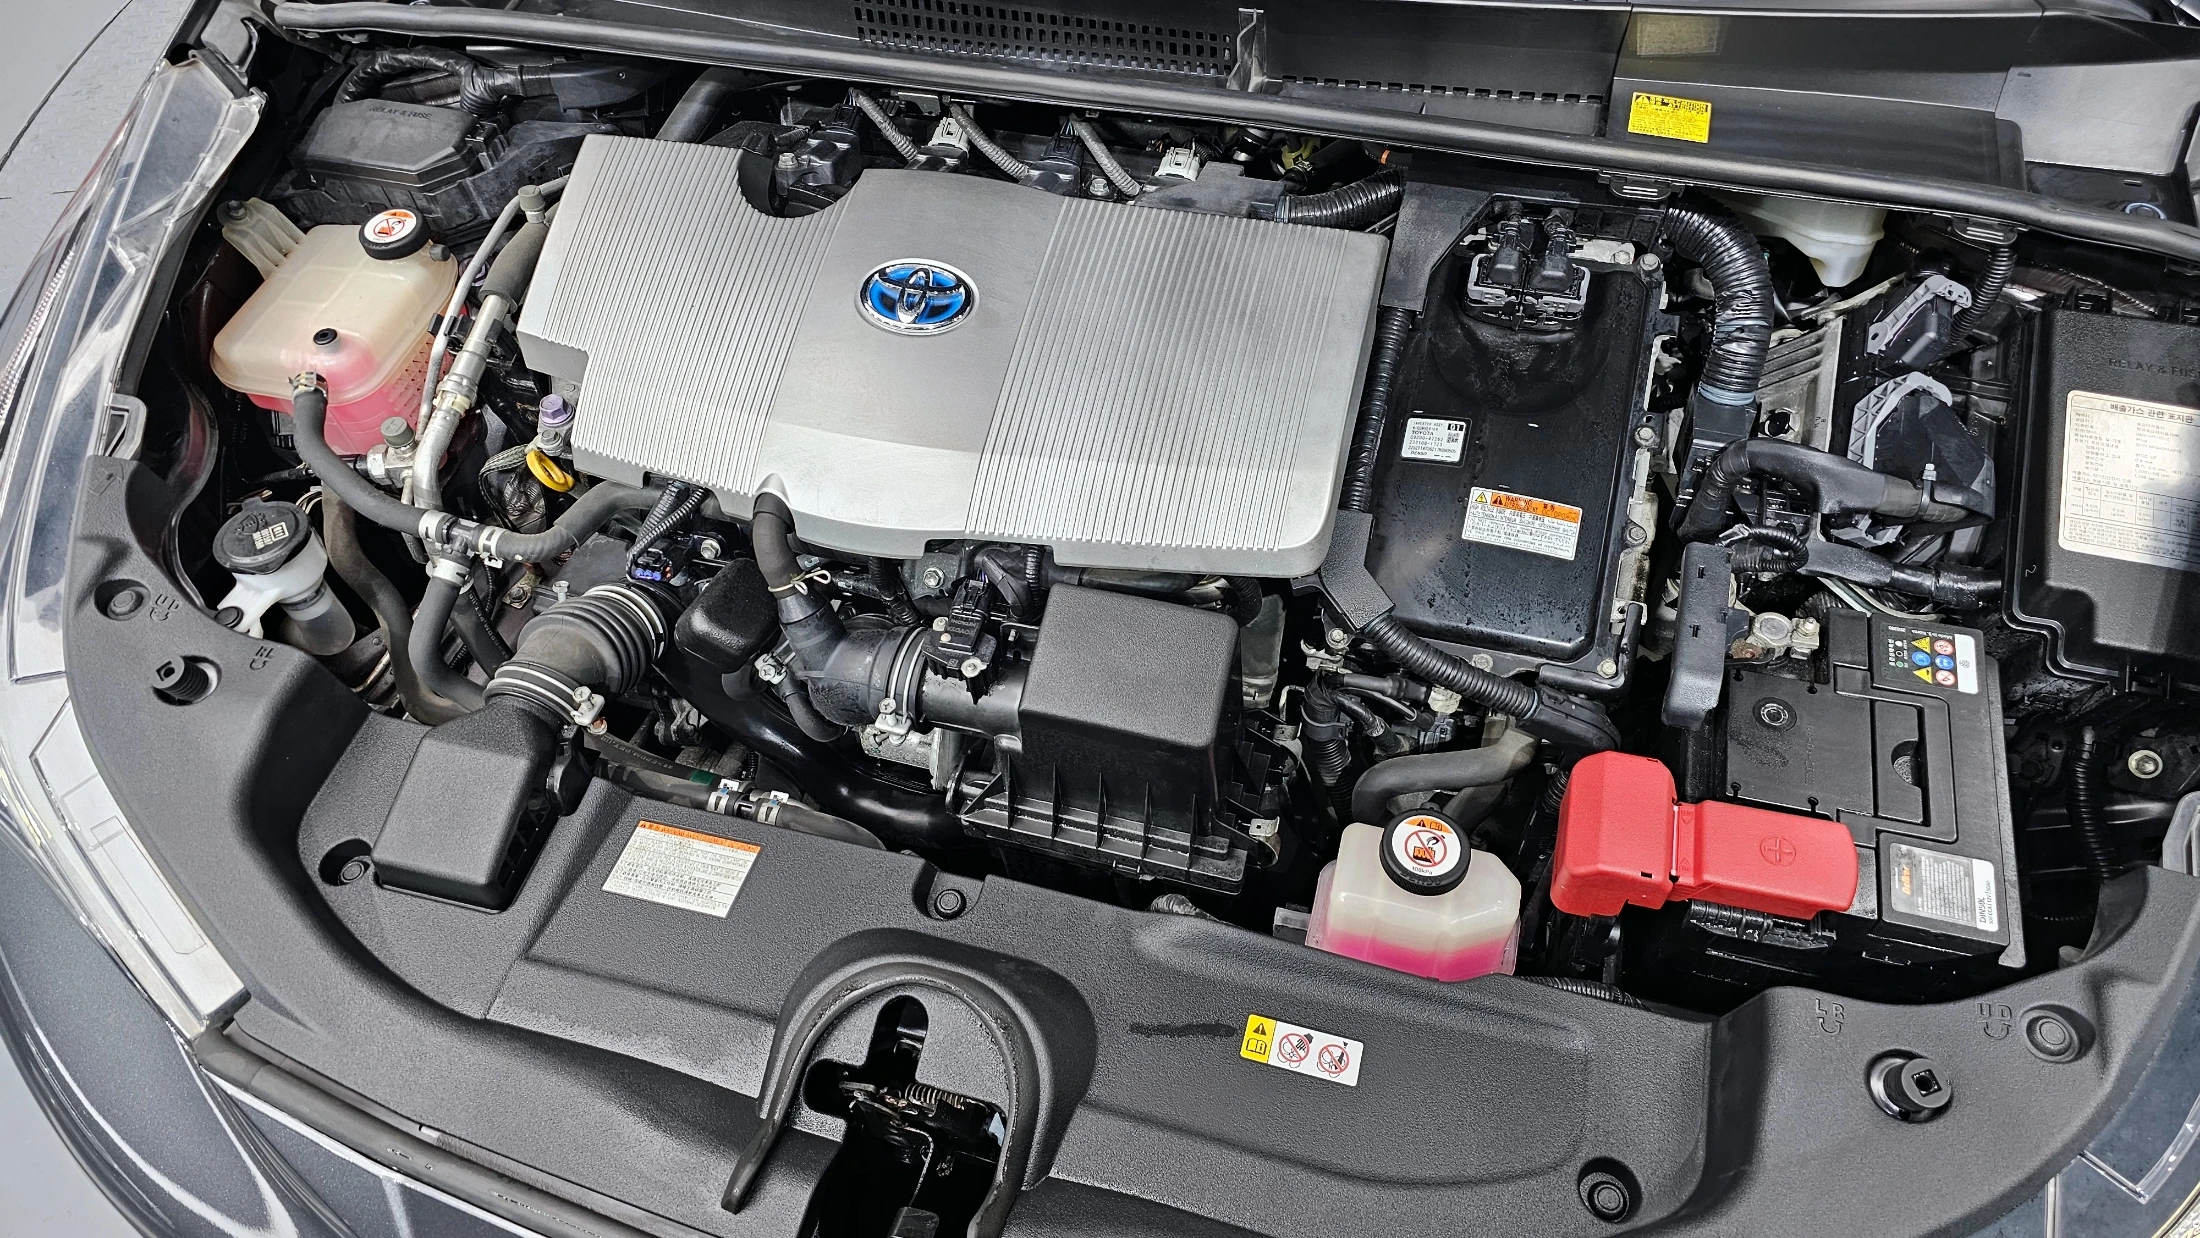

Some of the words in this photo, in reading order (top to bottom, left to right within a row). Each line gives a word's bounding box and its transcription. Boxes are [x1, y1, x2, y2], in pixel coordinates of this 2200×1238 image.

[2108, 358, 2153, 372] RELAY
[2157, 365, 2166, 375] &
[2110, 403, 2145, 416] 배출가스
[2147, 408, 2165, 419] 관련
[2168, 412, 2194, 424] 표지판
[1411, 866, 1433, 876] 108kPa
[1901, 864, 1912, 896] Delkor
